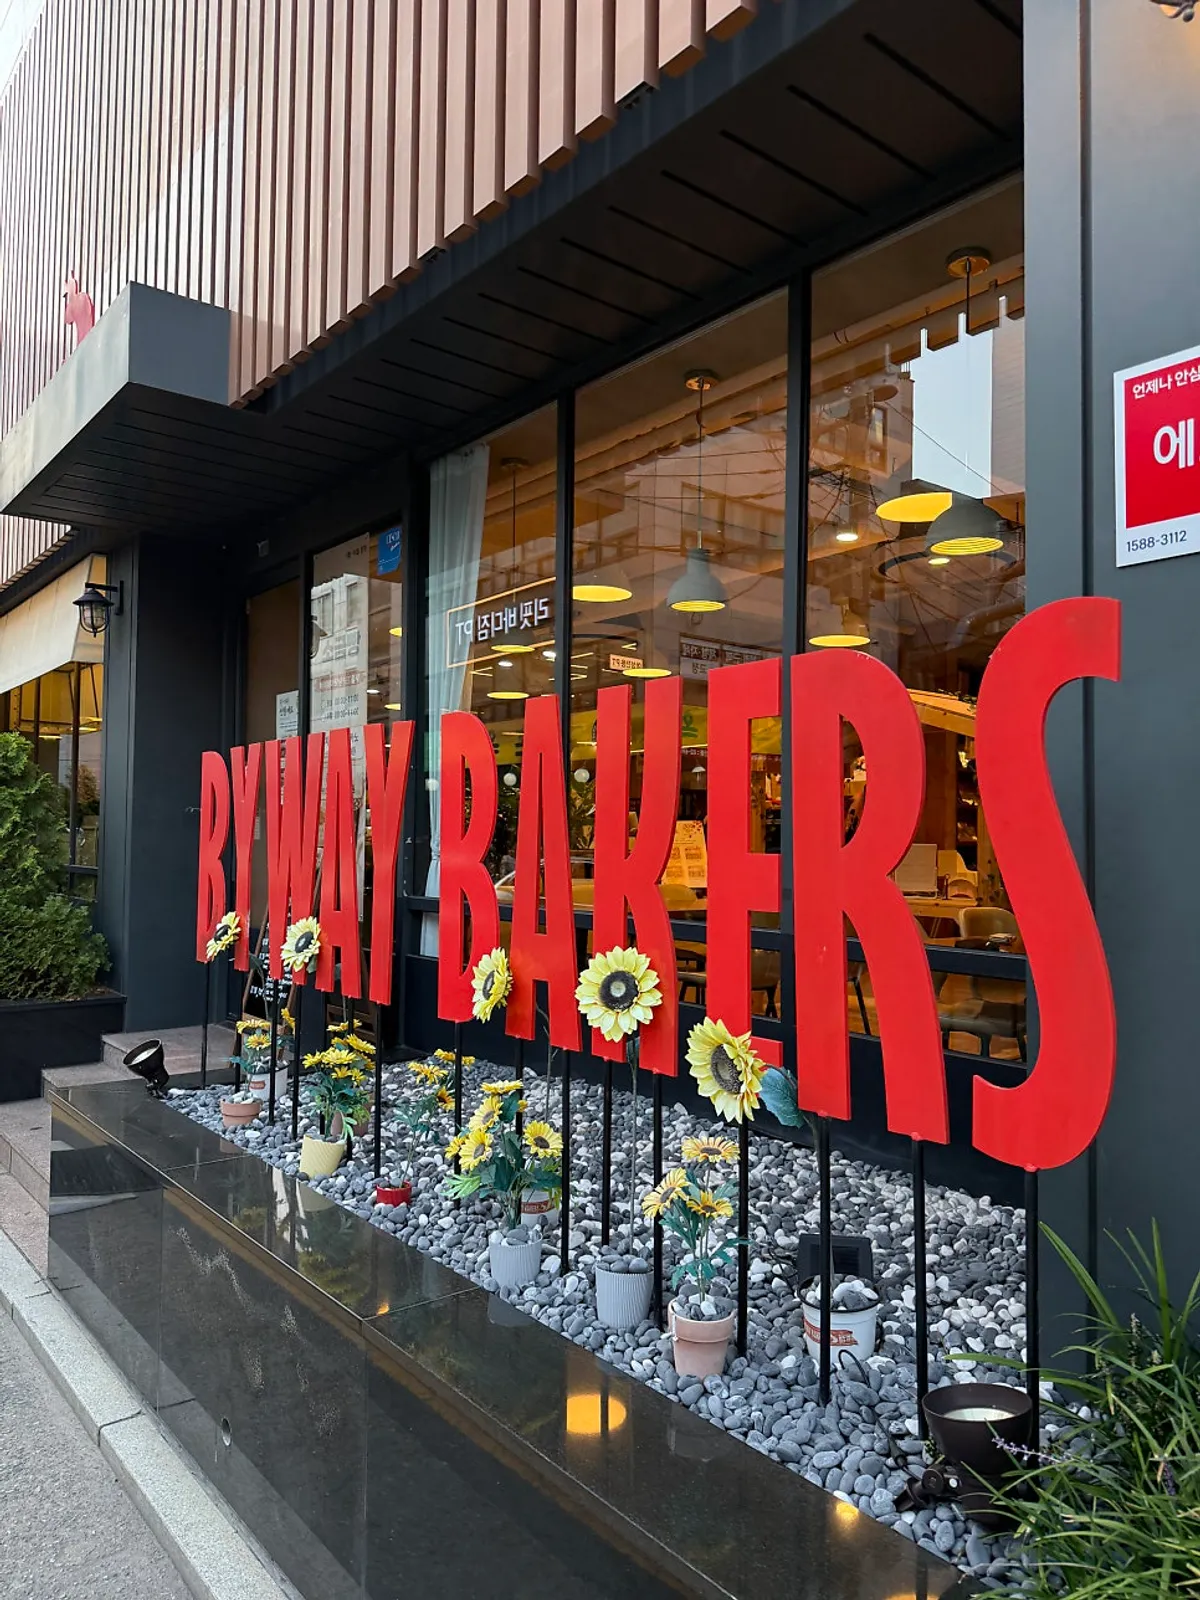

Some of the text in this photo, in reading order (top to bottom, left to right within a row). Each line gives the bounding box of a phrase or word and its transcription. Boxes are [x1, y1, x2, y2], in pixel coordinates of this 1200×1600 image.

[1132, 374, 1173, 399] 언제나
[1153, 418, 1200, 469] 에
[1126, 530, 1187, 552] 1588-3112
[438, 596, 1122, 1171] BAKERS
